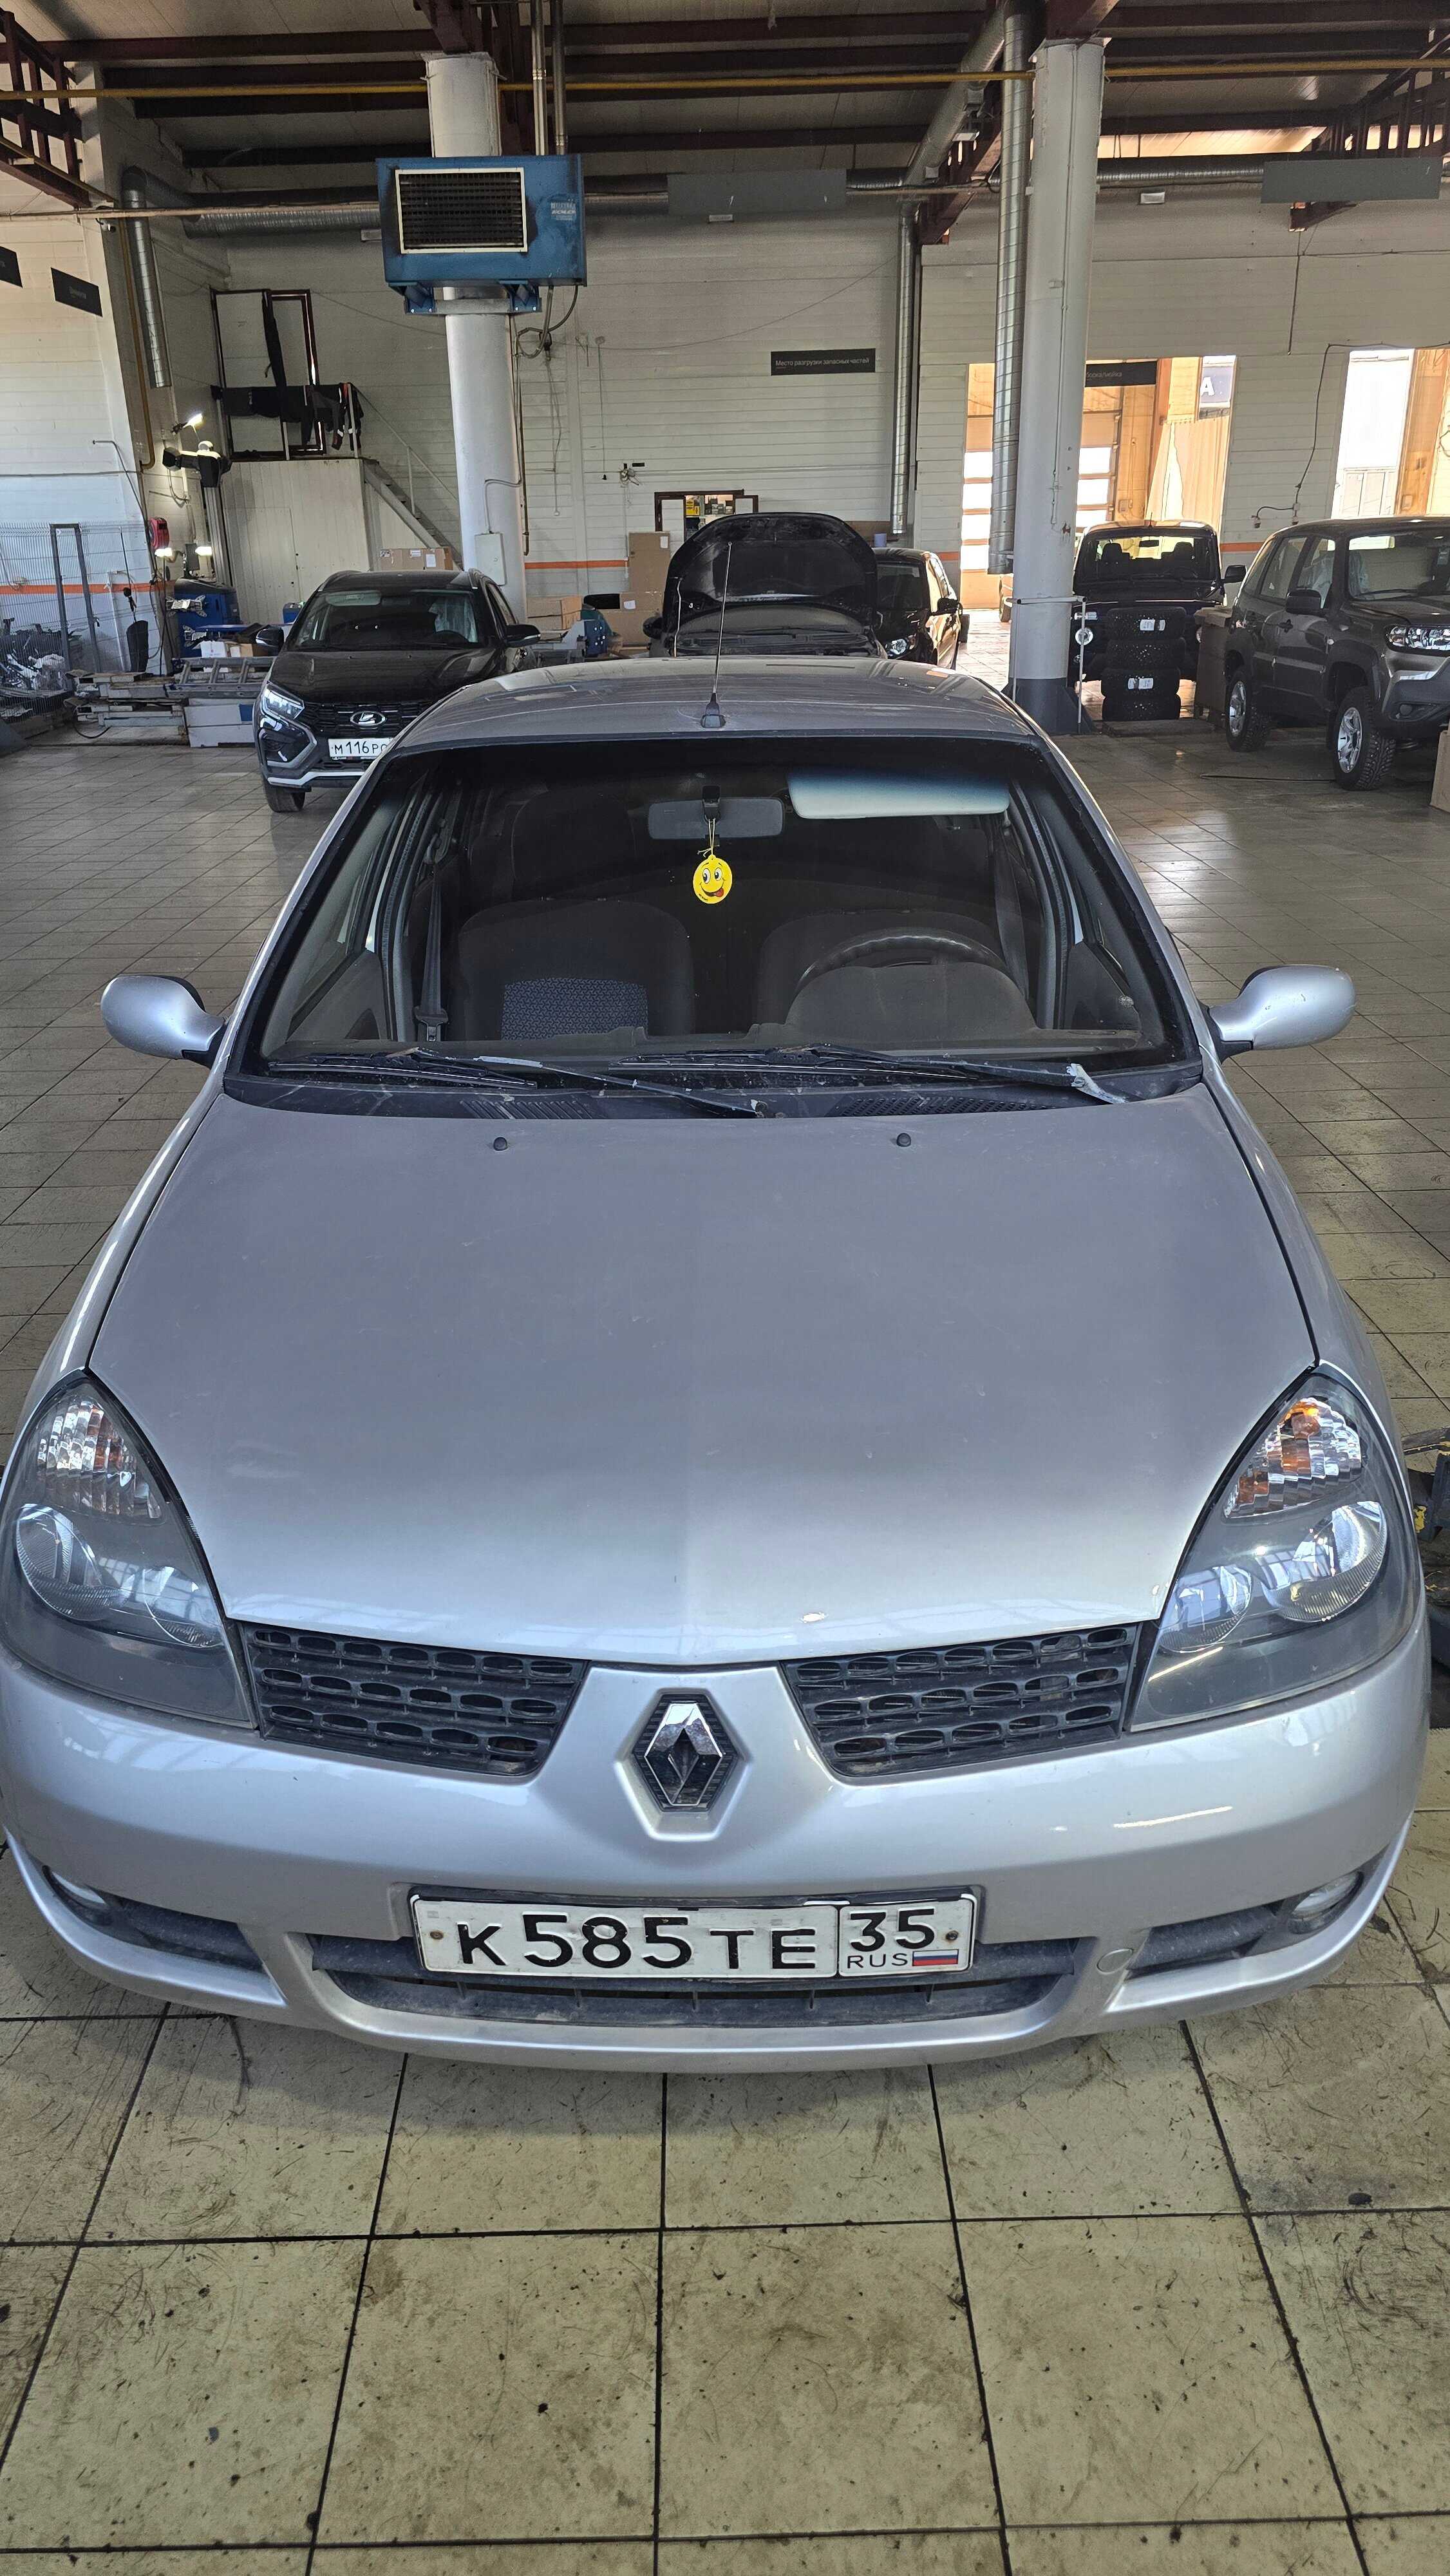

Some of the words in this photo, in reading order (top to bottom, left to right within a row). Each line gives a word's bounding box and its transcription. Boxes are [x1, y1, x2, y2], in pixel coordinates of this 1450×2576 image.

[457, 1913, 816, 1969] К585ТЕ
[850, 1908, 936, 1952] 35
[847, 1953, 909, 1969] RUS
